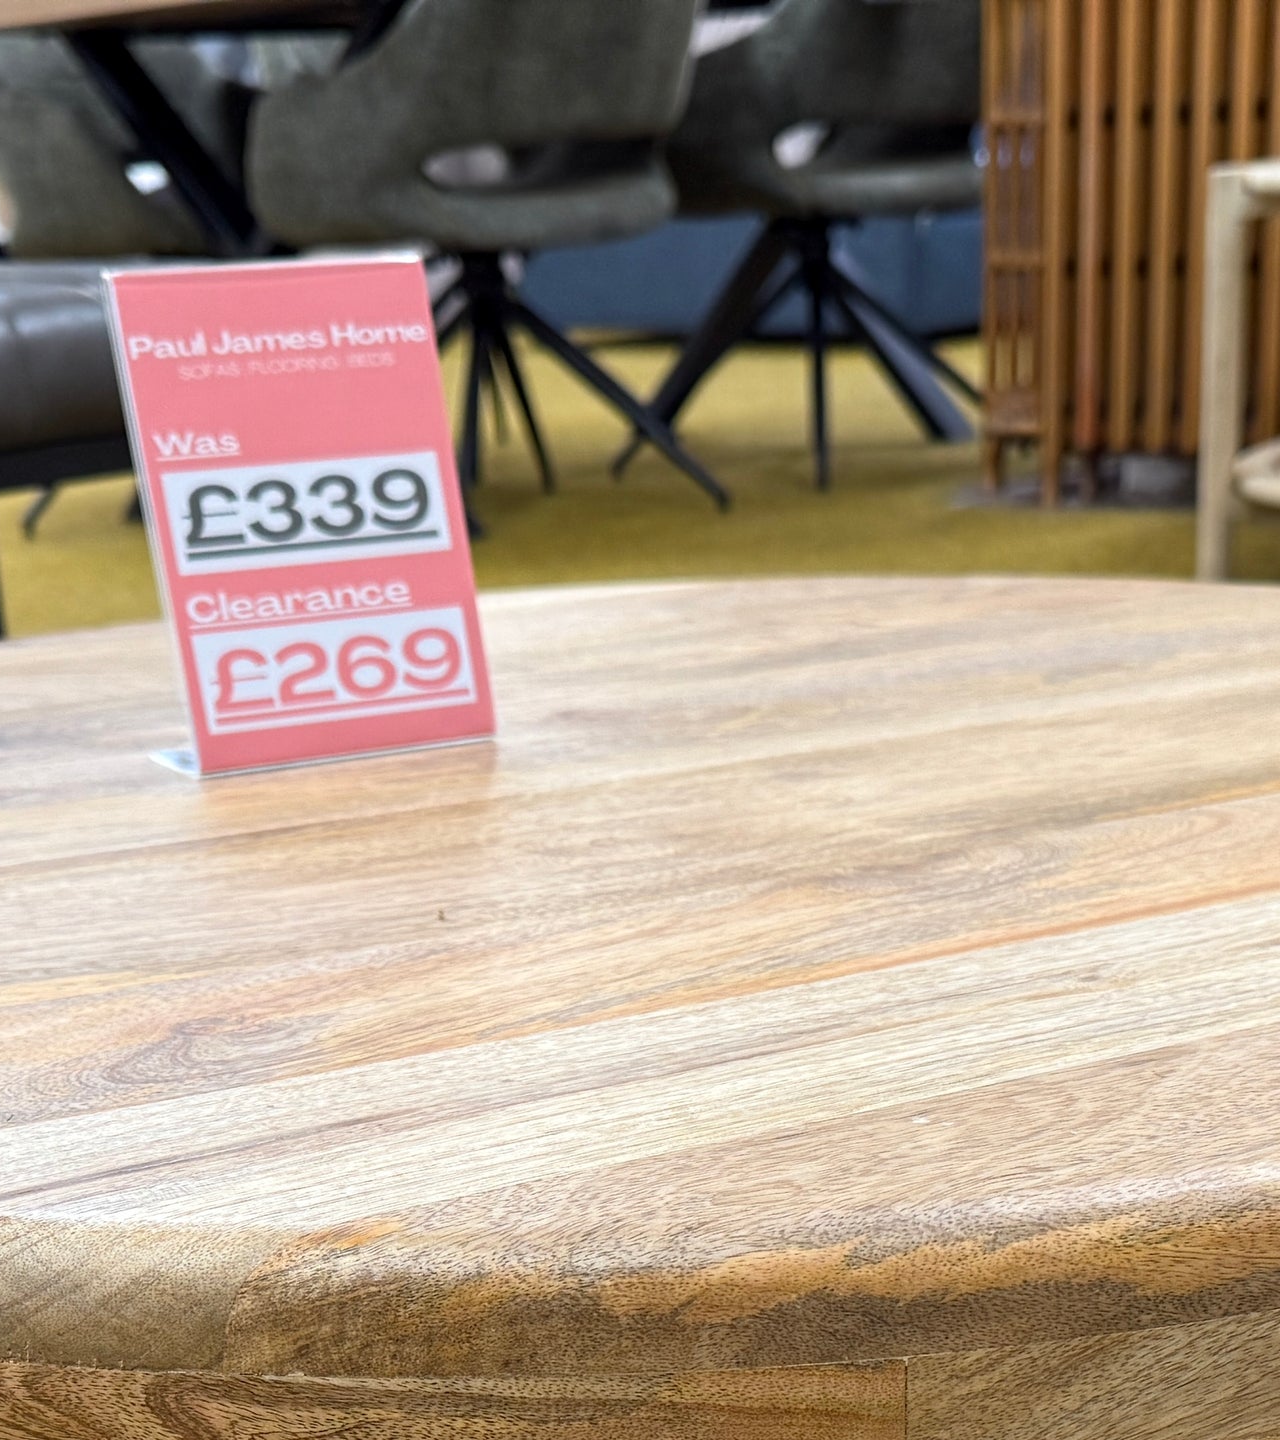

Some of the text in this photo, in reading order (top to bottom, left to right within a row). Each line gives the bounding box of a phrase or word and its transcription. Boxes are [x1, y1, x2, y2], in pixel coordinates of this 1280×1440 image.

[128, 322, 428, 360] Paul James Home
[152, 431, 240, 457] Was
[182, 468, 429, 548] £339
[186, 579, 412, 625] Clearance
[210, 627, 463, 713] £269
